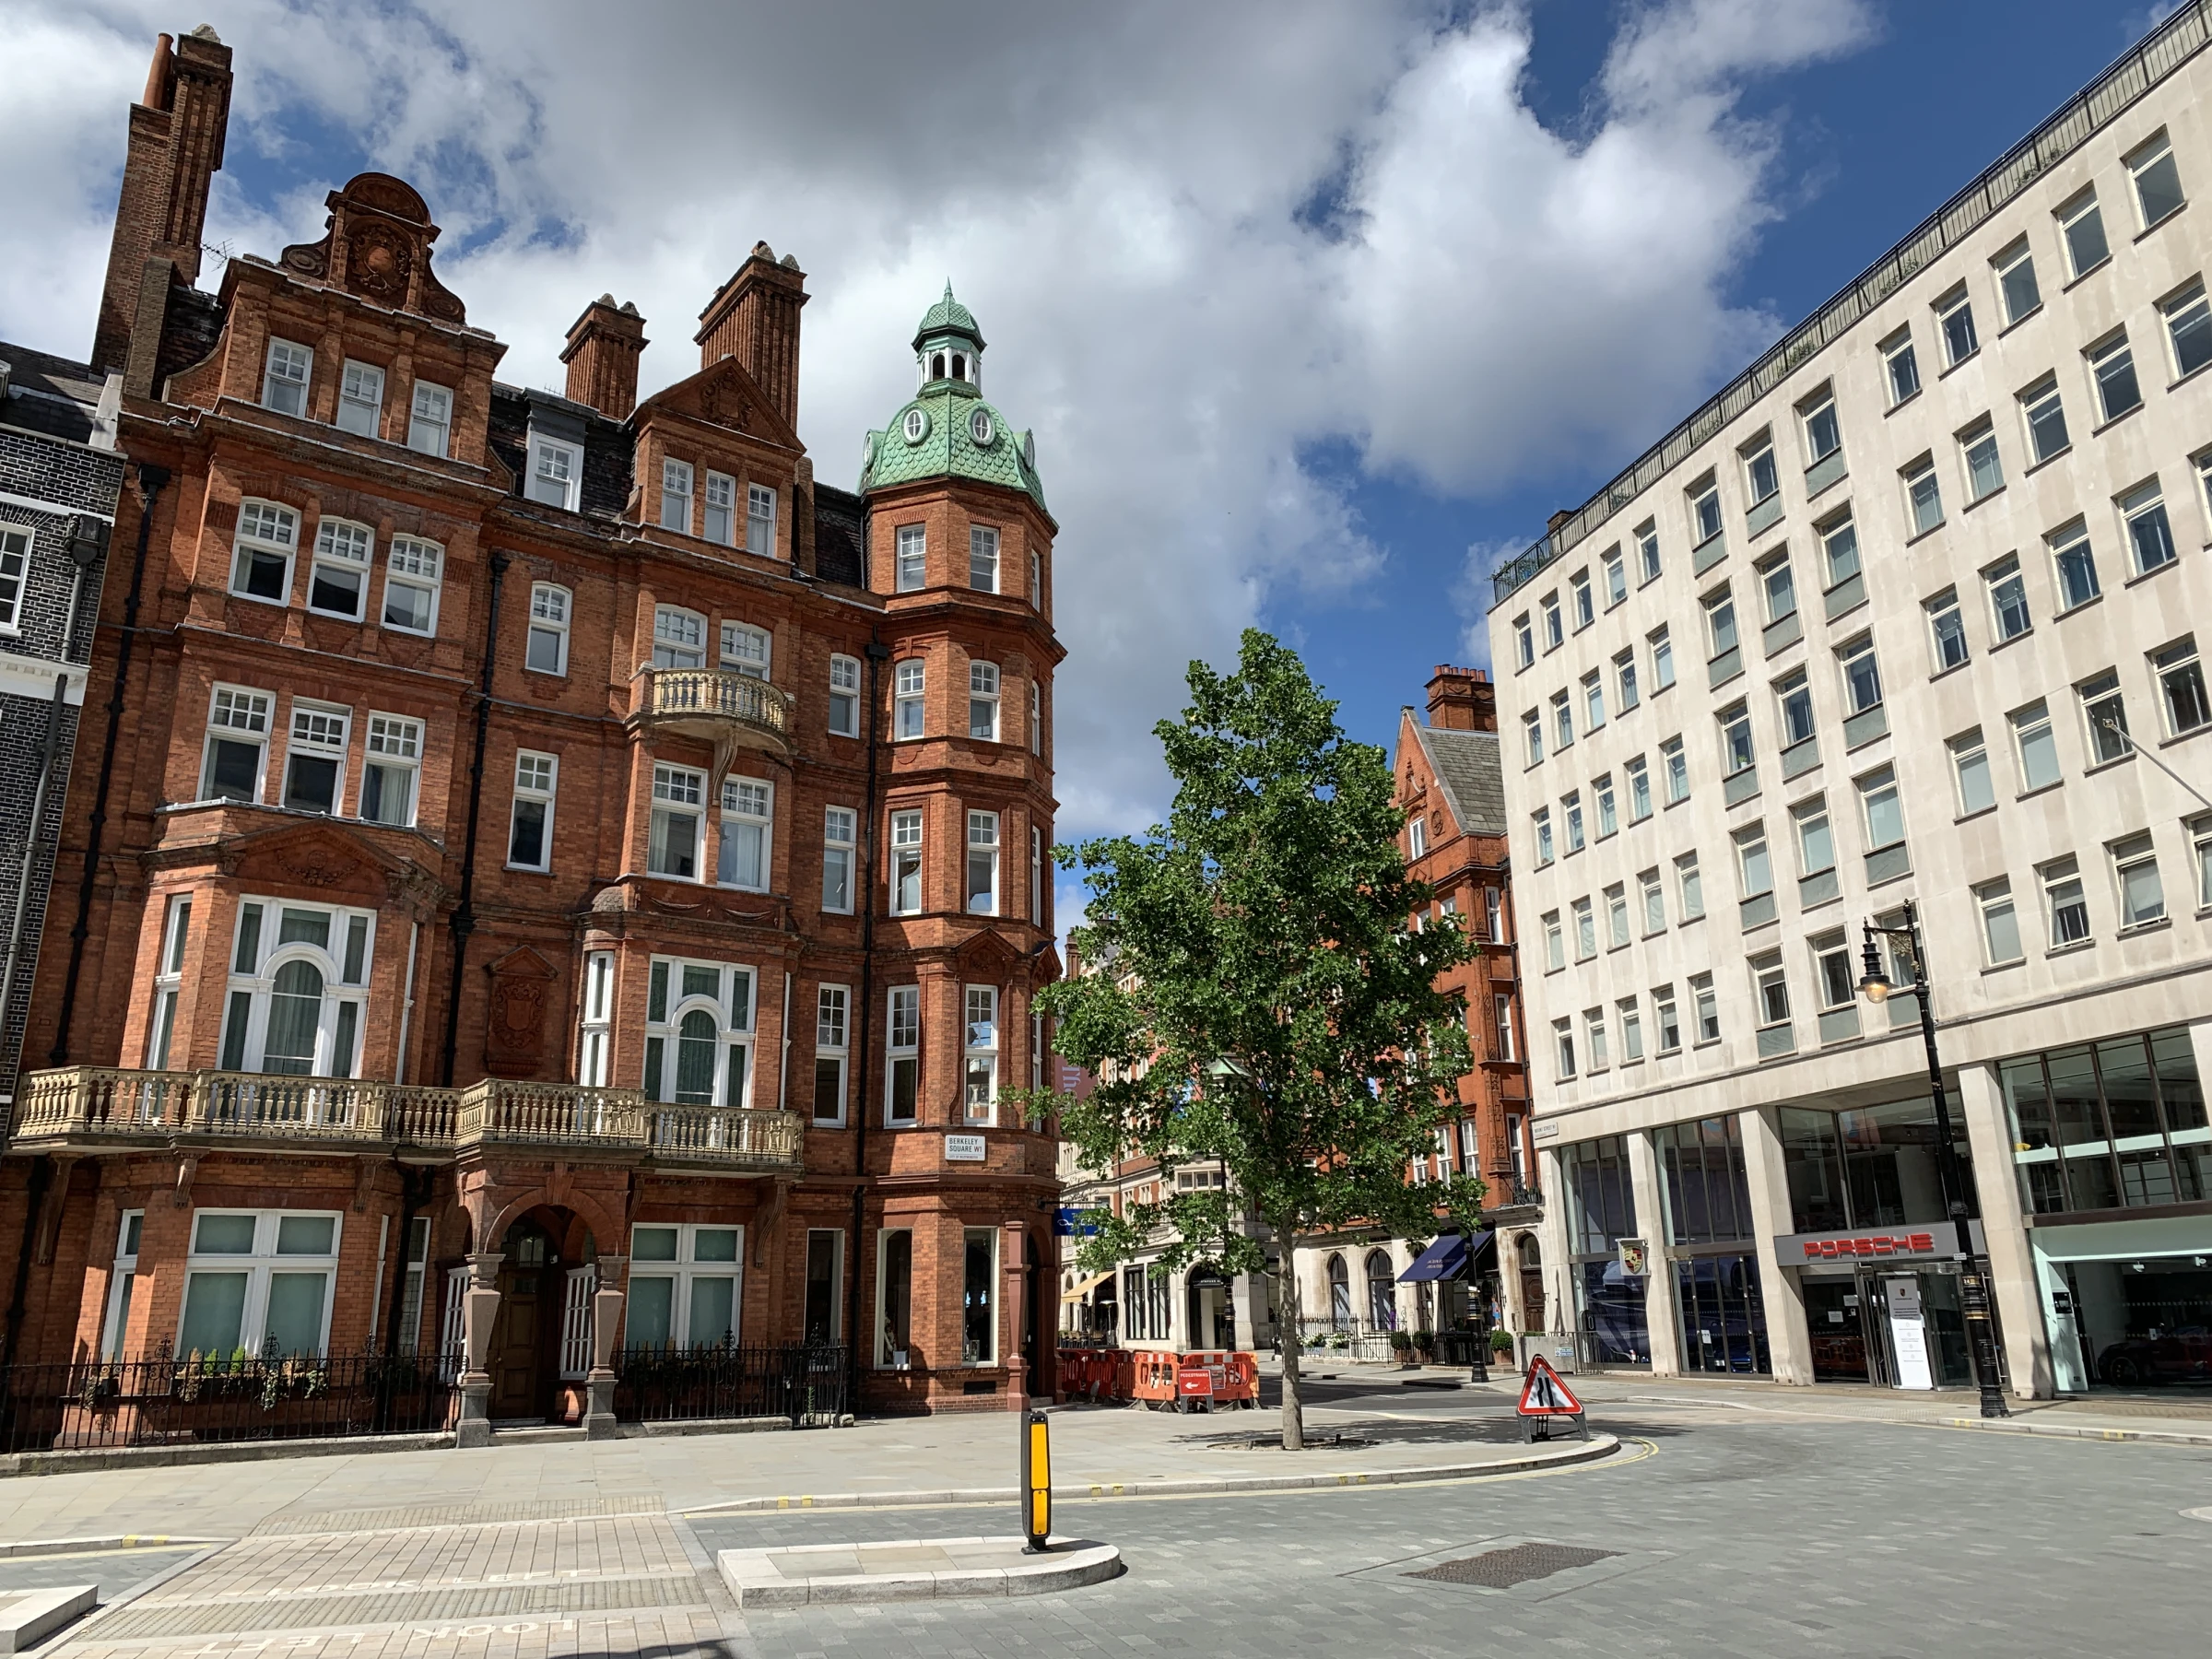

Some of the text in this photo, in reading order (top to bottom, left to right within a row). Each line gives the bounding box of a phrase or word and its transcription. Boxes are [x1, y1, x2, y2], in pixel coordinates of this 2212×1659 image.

[1804, 1233, 1933, 1257] PORSCHE
[265, 1569, 591, 1596] LOOK LEFT
[182, 1619, 573, 1655] LOOK LEFT
